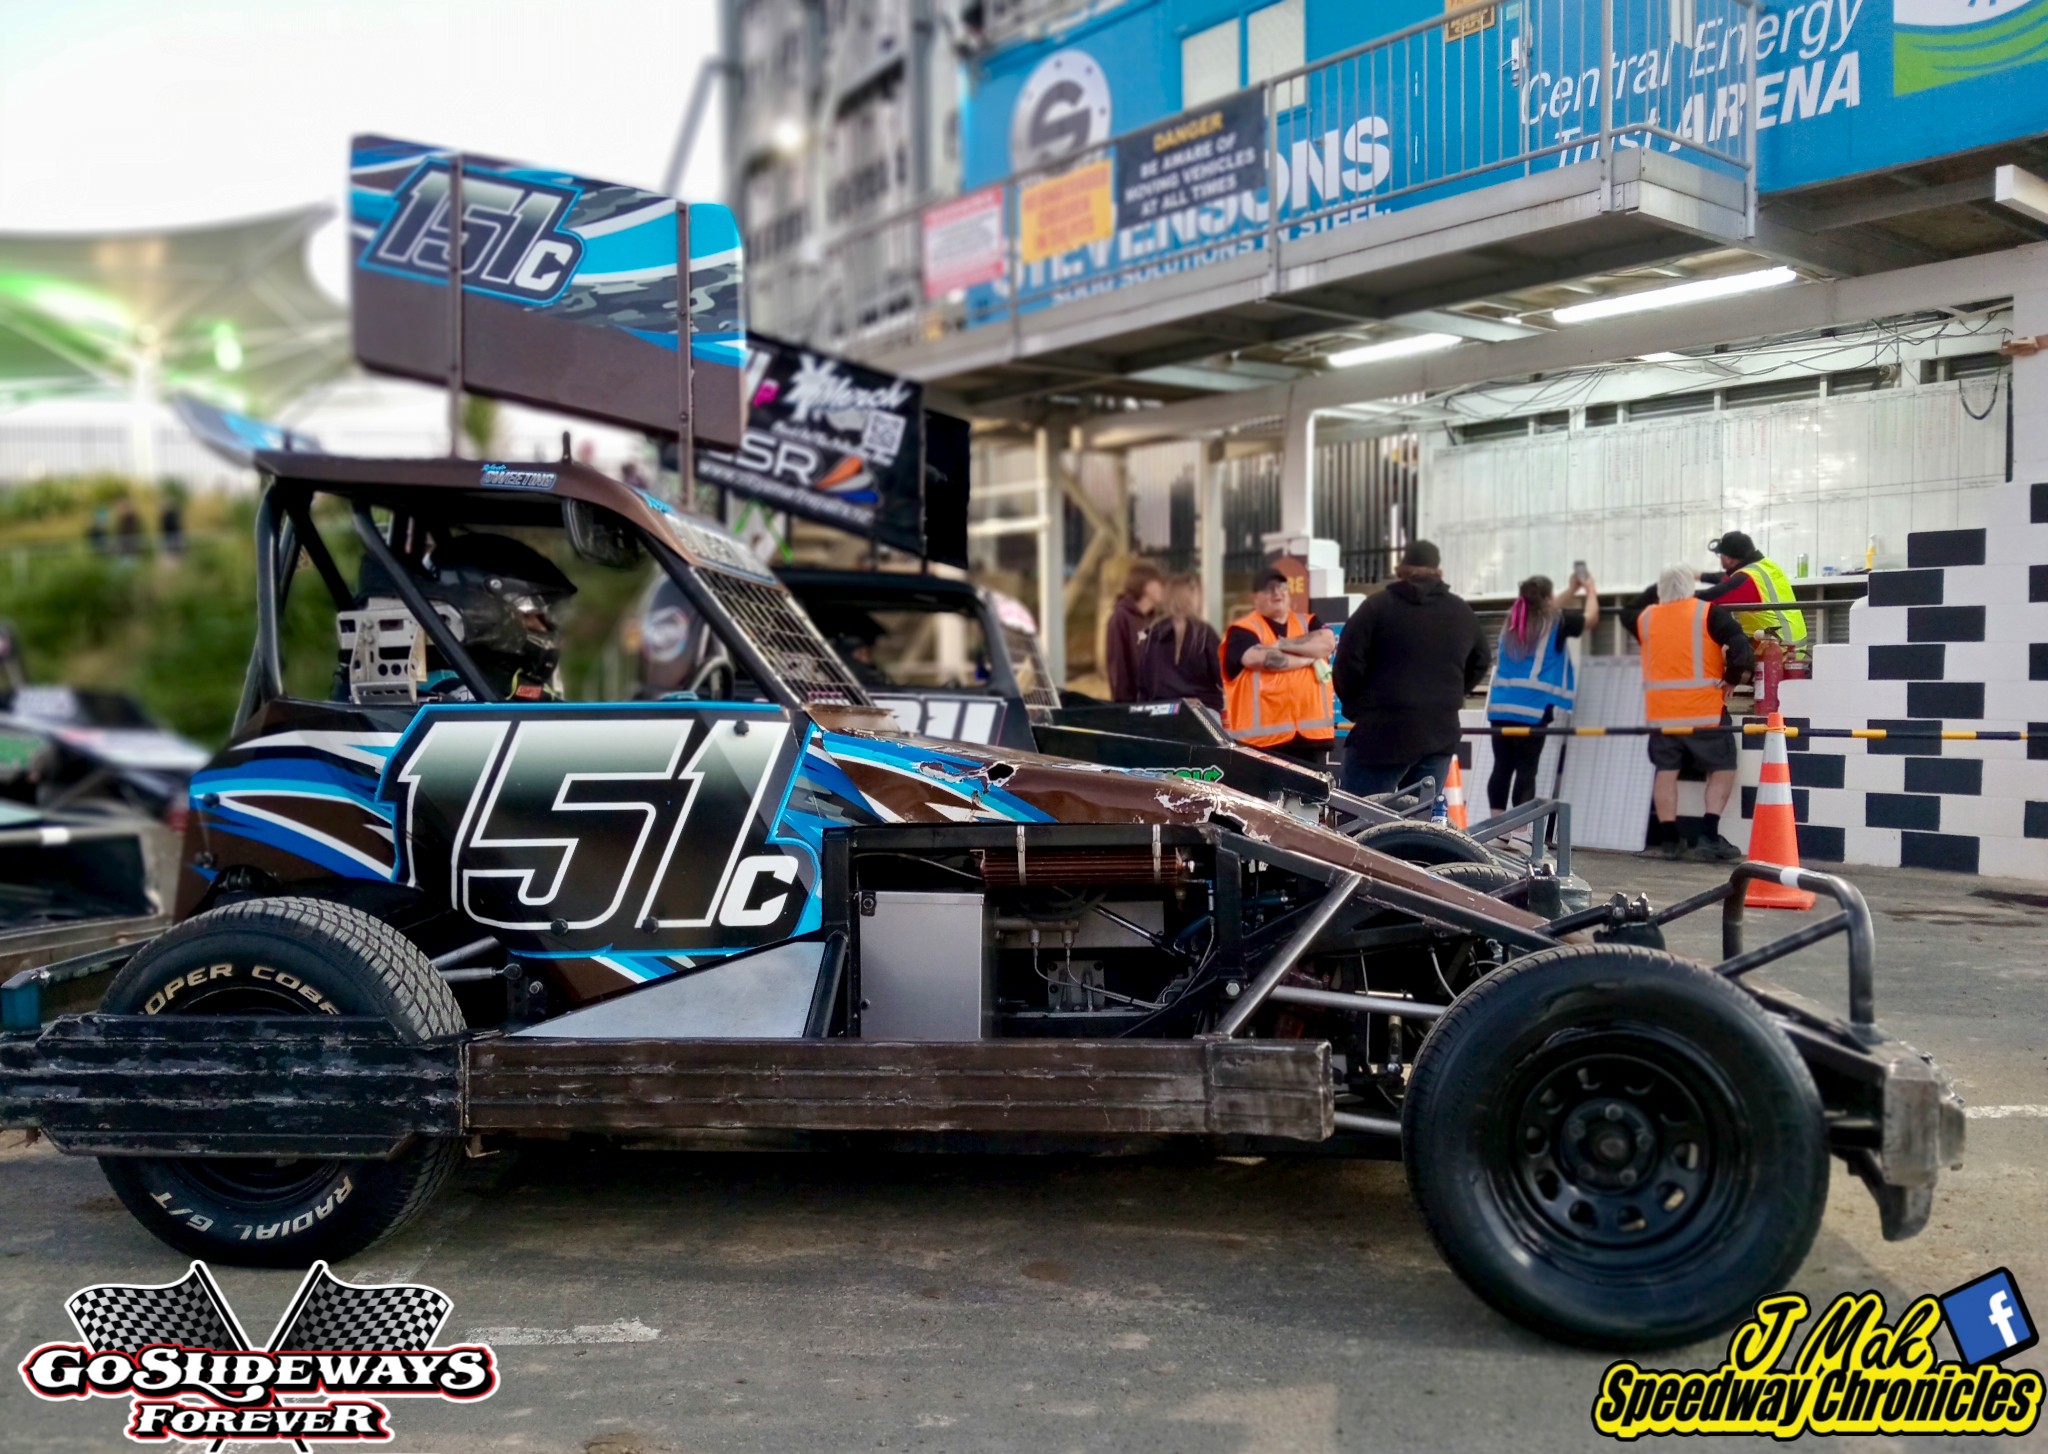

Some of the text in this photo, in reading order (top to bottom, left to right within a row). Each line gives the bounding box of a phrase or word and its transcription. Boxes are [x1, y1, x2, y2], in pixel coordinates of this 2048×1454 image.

[1521, 0, 1865, 125] Central Energy
[1668, 51, 1861, 153] ARENA
[1139, 133, 1238, 179] BE AWARE OF
[1152, 112, 1224, 153] DANGER
[1124, 148, 1256, 202] MOVING VEHICLES
[1140, 174, 1238, 216] AT ALL TIMES
[707, 431, 818, 486] SR
[143, 963, 234, 1015] OPER
[232, 1175, 354, 1240] RADIAL
